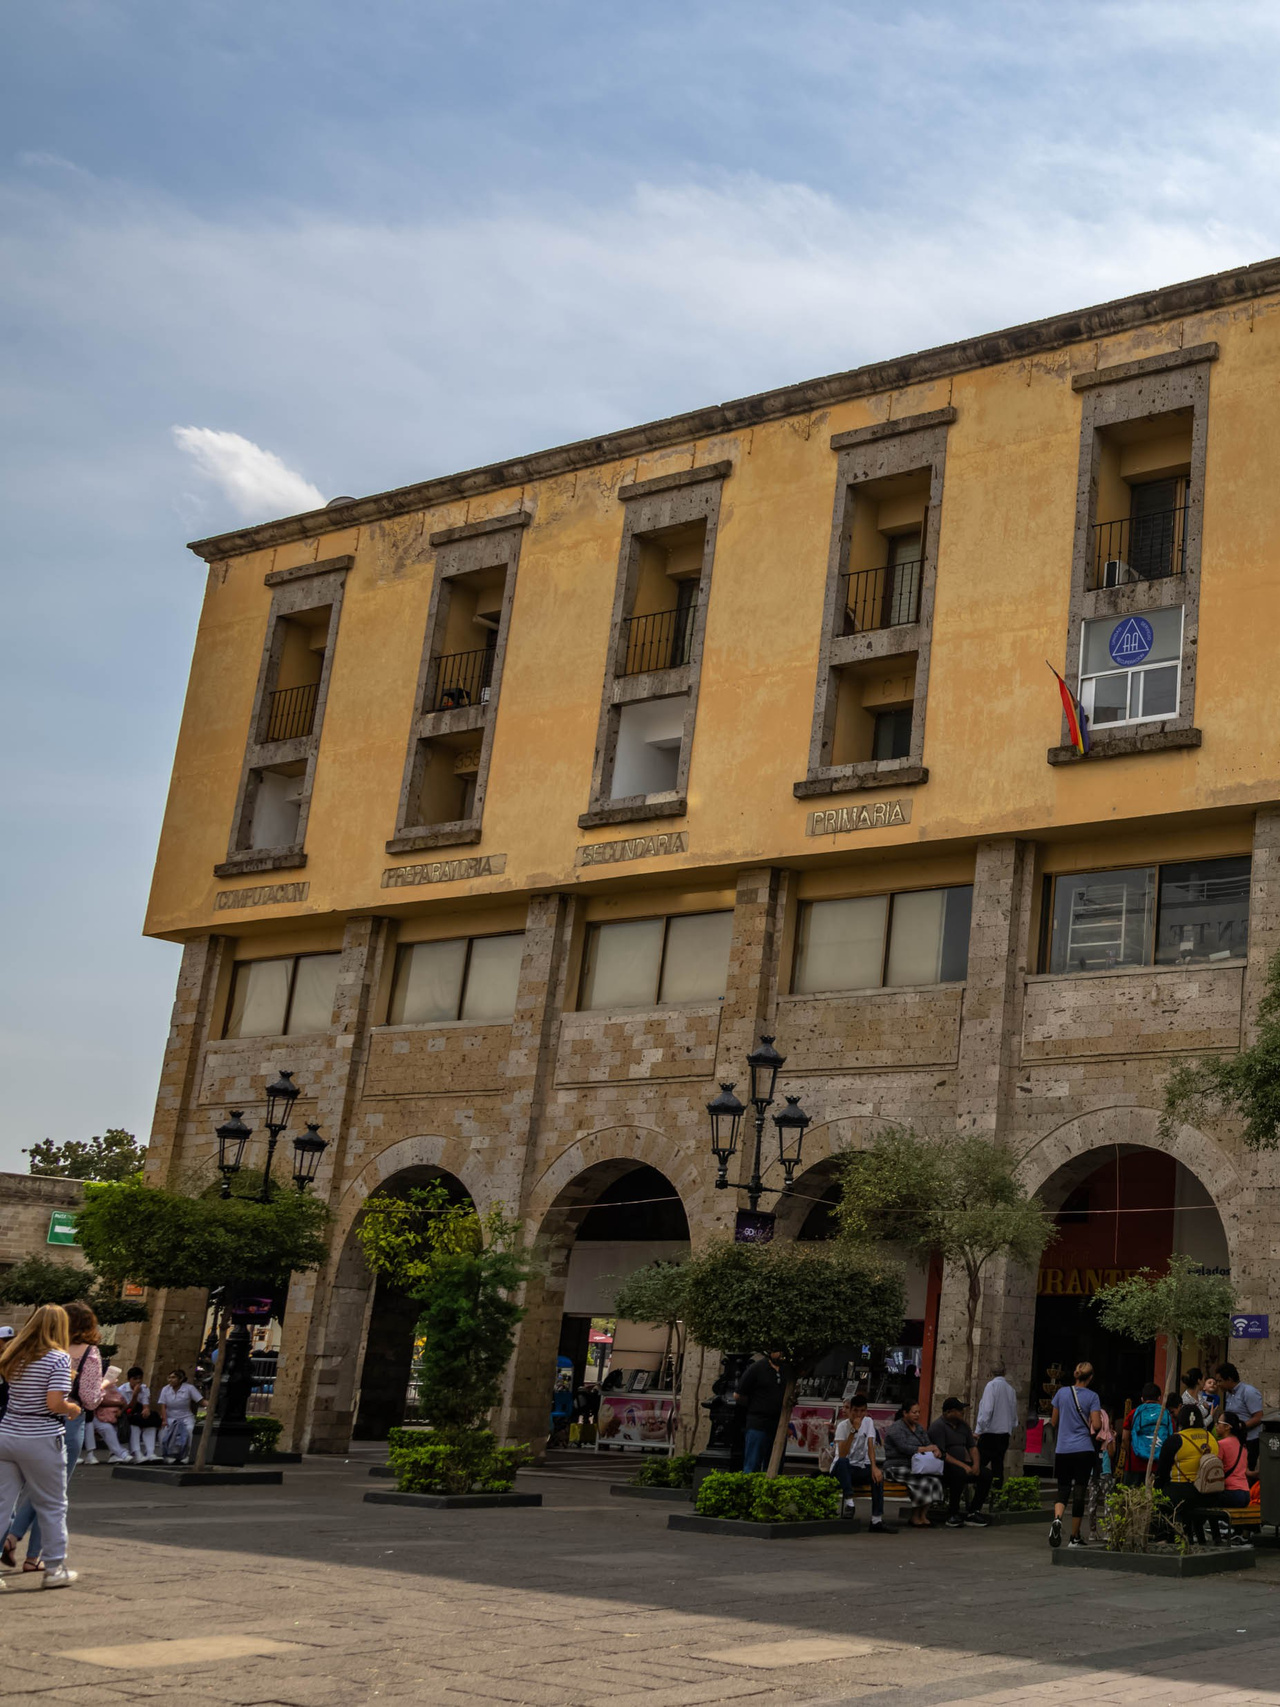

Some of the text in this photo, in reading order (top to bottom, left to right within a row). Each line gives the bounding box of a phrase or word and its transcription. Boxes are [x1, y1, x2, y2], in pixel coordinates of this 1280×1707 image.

[1123, 632, 1139, 653] AA
[812, 800, 908, 836] PRIMARIA
[581, 833, 688, 864] SECUNDARIA
[386, 856, 494, 888] PREPARATORIA
